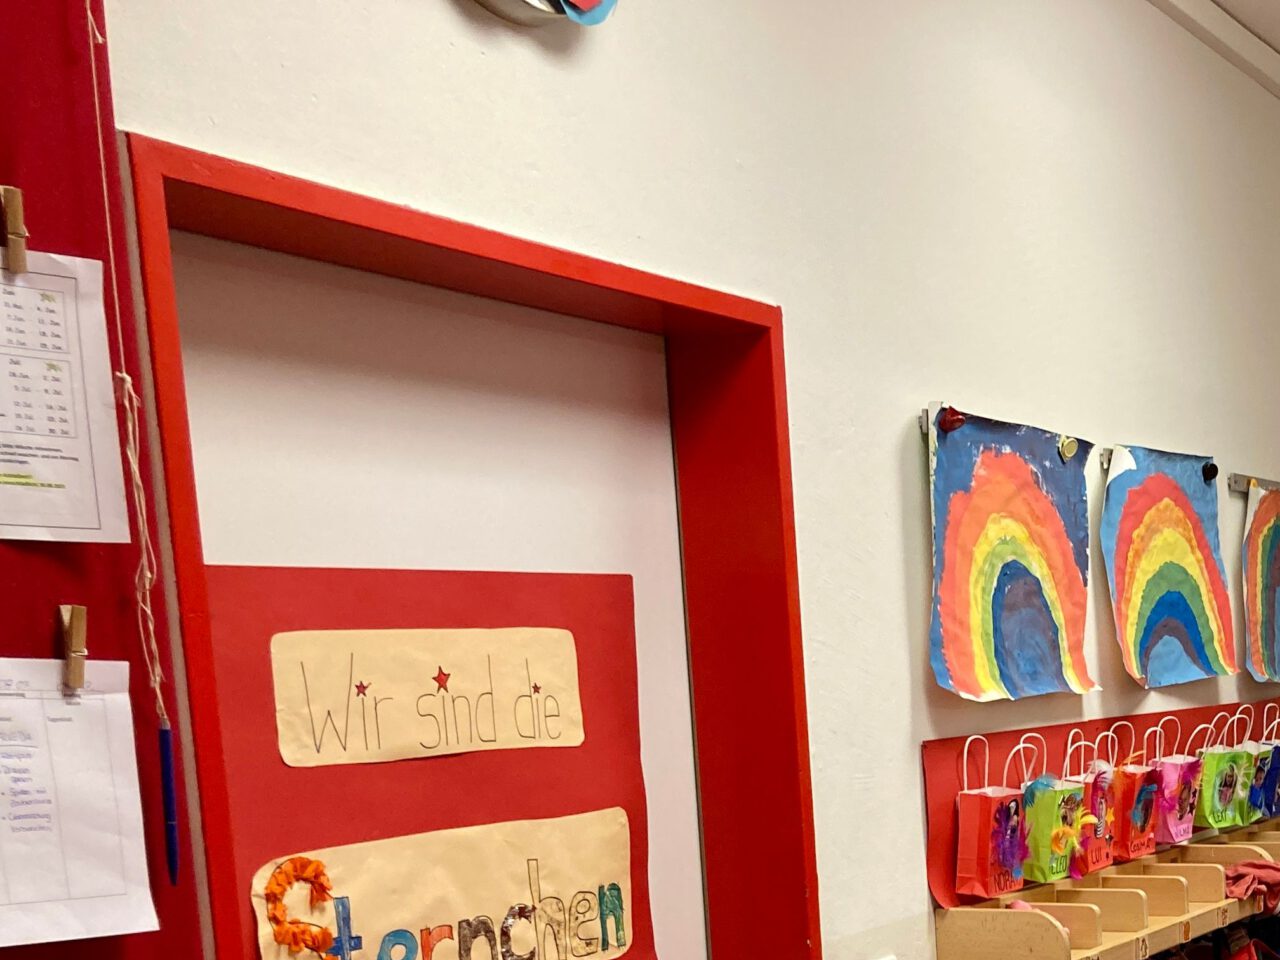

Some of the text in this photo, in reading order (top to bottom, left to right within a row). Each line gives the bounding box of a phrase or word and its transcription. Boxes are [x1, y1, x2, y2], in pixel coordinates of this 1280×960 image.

[301, 652, 562, 754] Wir sind die
[993, 870, 1016, 893] NORA
